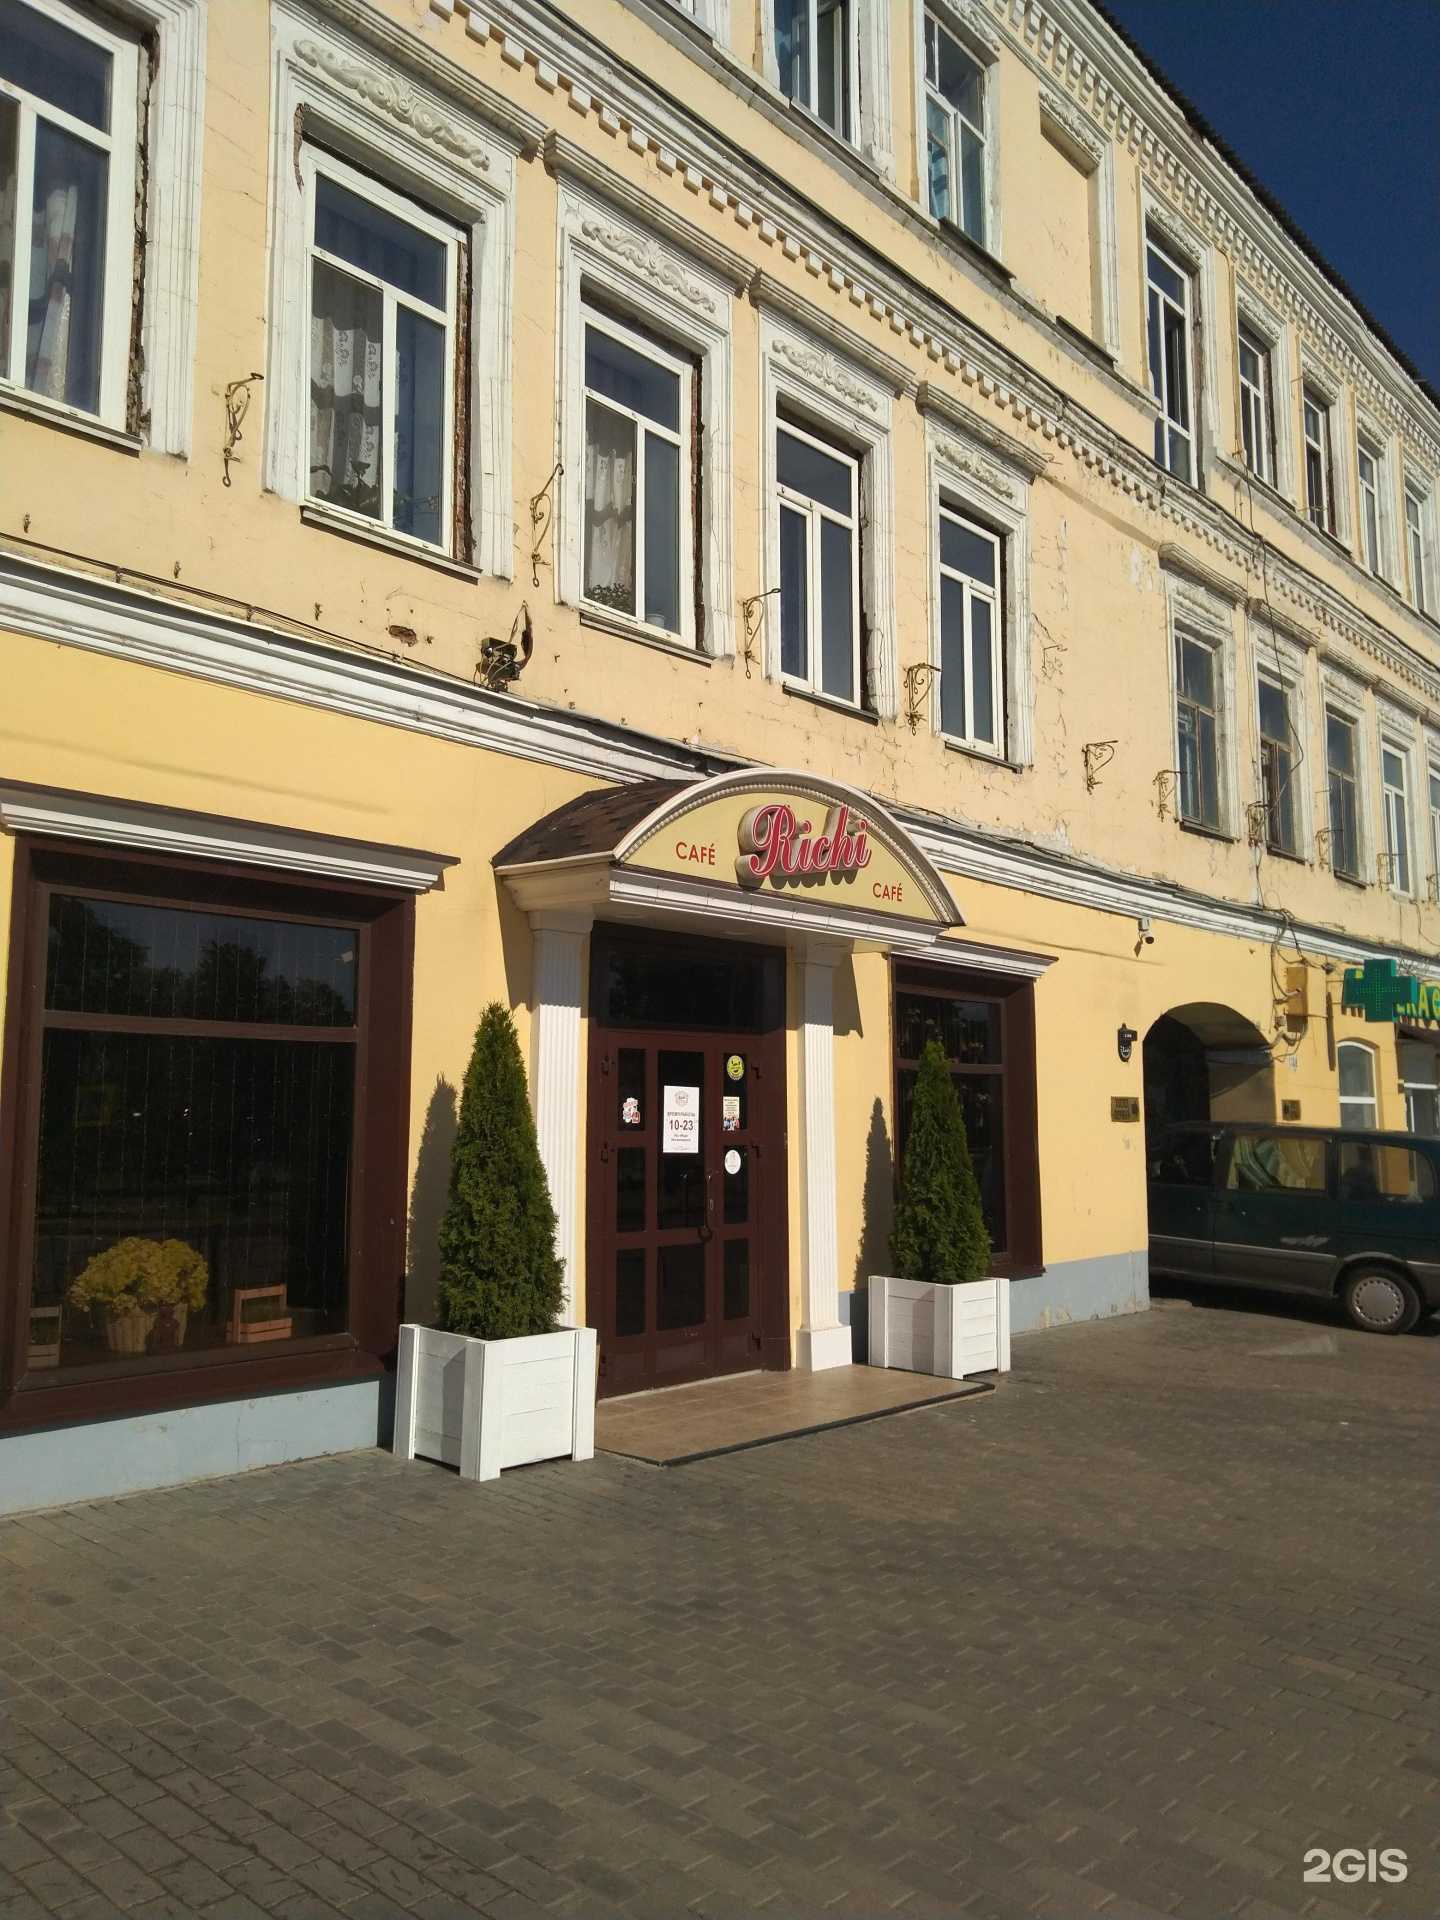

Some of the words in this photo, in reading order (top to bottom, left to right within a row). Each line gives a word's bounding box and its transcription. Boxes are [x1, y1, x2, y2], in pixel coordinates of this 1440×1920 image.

[749, 802, 871, 876] Richi
[675, 841, 716, 866] CAFÉ
[872, 882, 903, 902] CAFÉ
[669, 1119, 694, 1131] 10-23
